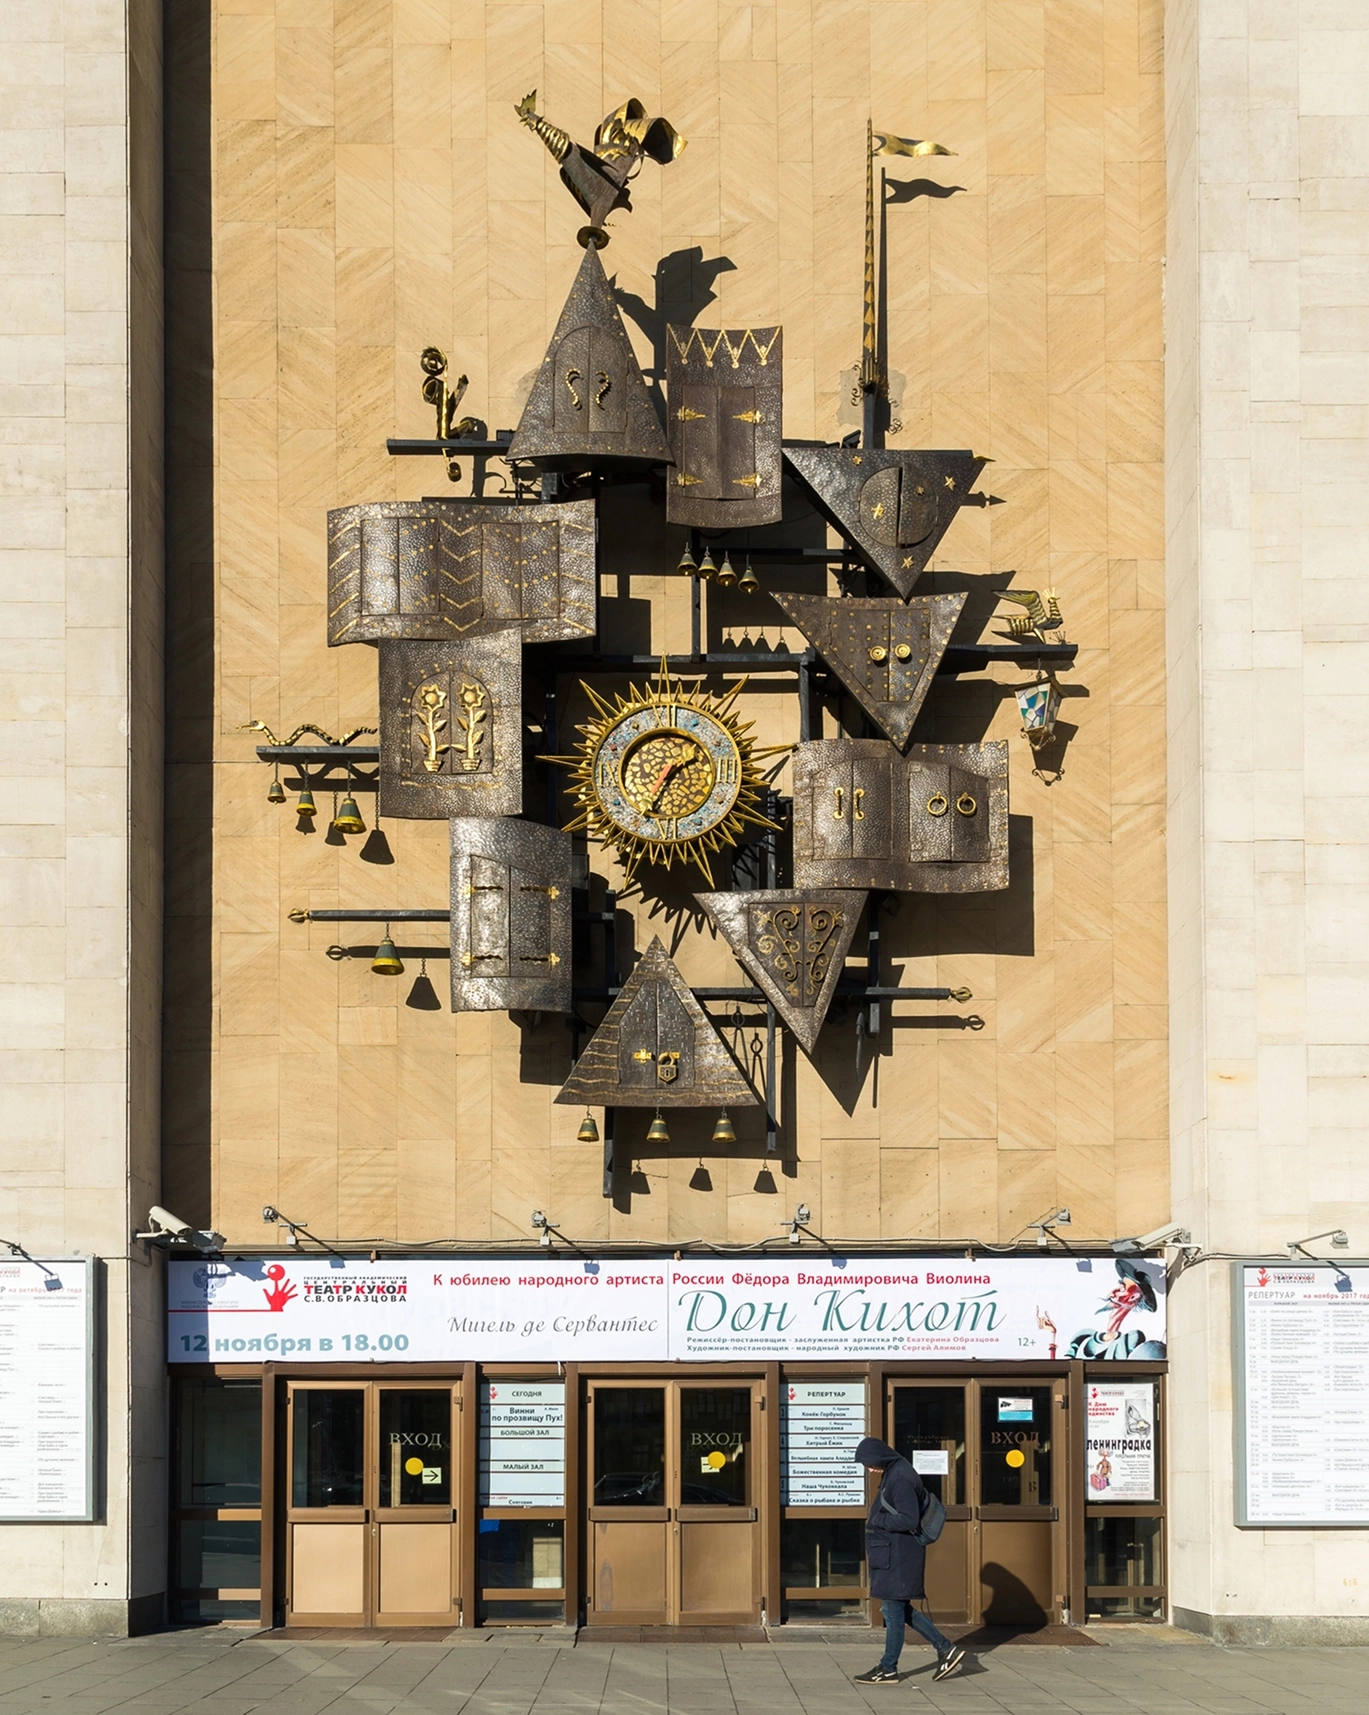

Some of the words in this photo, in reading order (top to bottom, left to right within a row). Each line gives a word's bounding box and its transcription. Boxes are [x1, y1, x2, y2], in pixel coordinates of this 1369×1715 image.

[717, 757, 737, 783] III
[433, 1274, 442, 1285] К
[450, 1273, 511, 1286] юбилею
[518, 1275, 599, 1288] народного
[606, 1275, 664, 1288] артиста
[672, 1272, 725, 1285] России
[732, 1272, 790, 1287] Фёдора
[797, 1272, 918, 1287] Владимировича
[926, 1272, 991, 1284] Виолина
[304, 1285, 353, 1294] ТЕАТР
[355, 1285, 407, 1294] КУКОЛ
[1248, 1291, 1296, 1299] РЕПЕРТУАР
[678, 1289, 797, 1332] Дон
[813, 1289, 1007, 1332] Кихот
[447, 1316, 518, 1333] Мигель
[521, 1321, 547, 1337] де
[552, 1314, 659, 1337] Сервантес
[180, 1334, 207, 1351] 12
[215, 1333, 312, 1356] ноября
[319, 1338, 333, 1351] в
[341, 1334, 409, 1351] 18.00
[686, 1336, 787, 1344] Режиссёр-постановщик
[906, 1336, 951, 1344] Екатерина
[952, 1336, 1000, 1344] Образцова
[1017, 1337, 1037, 1347] 12+
[686, 1344, 789, 1352] Художник-постановщик
[796, 1344, 840, 1352] народный
[901, 1344, 932, 1352] Сергей
[503, 1415, 544, 1423] прозвищу
[545, 1414, 563, 1423] Пух!
[500, 1428, 535, 1436] БОЛЬШОЙ
[690, 1432, 743, 1447] ВХОД
[990, 1431, 1041, 1447] ВХОД
[389, 1432, 442, 1448] ВХОД
[1086, 1439, 1152, 1454] ленинградка
[503, 1462, 530, 1470] МАЛЫЙ
